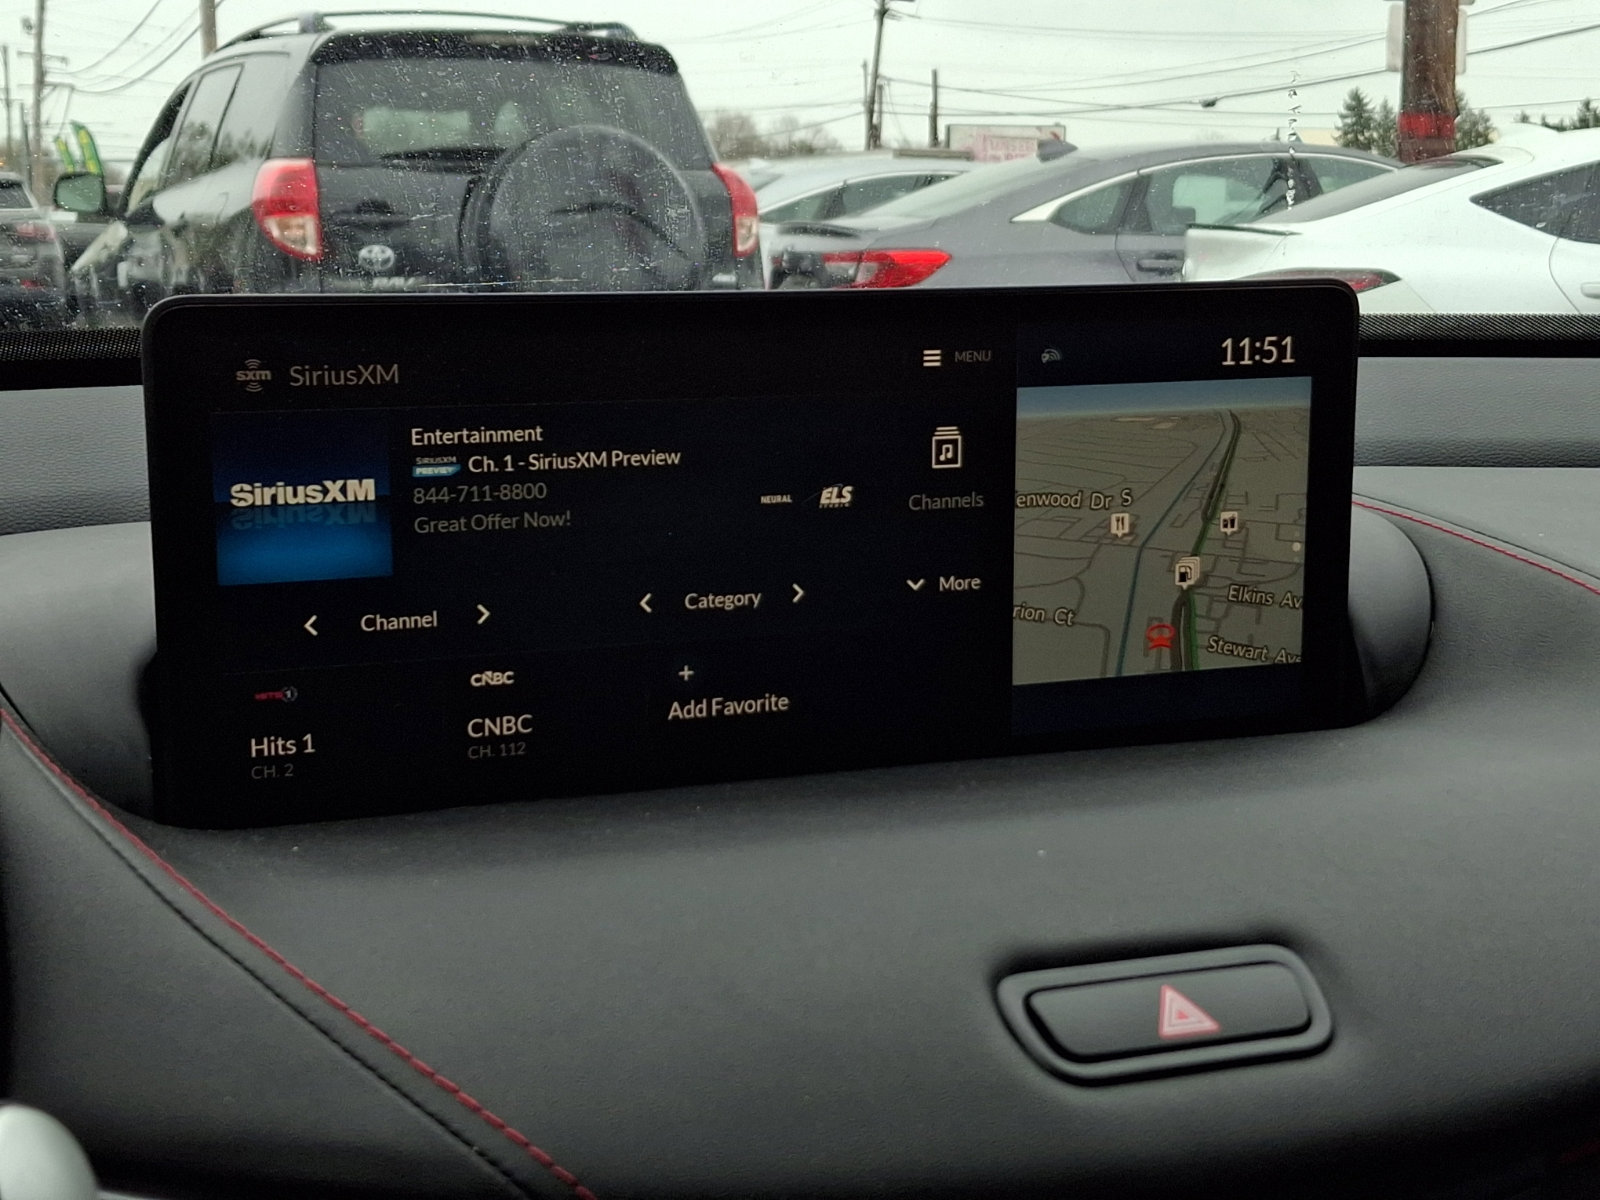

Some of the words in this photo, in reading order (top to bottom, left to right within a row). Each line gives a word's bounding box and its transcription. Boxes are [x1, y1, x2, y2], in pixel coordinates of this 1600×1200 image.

[954, 350, 992, 363] MENU
[1221, 335, 1296, 366] 11:51
[235, 367, 272, 382] sxm
[289, 363, 399, 387] SiriusXM
[411, 425, 543, 446] Entertainment
[468, 455, 499, 473] Ch.
[503, 454, 515, 472] 1
[528, 450, 608, 471] SiriusXM
[611, 448, 681, 467] Preview
[230, 478, 376, 507] SiriusXM
[413, 482, 548, 505] 844-711-8800
[820, 485, 853, 504] ELS
[908, 491, 985, 511] Channels
[1091, 493, 1112, 509] Dr
[1121, 489, 1132, 506] S
[414, 516, 468, 534] Great
[470, 513, 520, 531] Offer
[523, 509, 571, 529] Now!
[939, 575, 982, 592] More
[684, 592, 762, 611] Category
[1228, 585, 1273, 605] Elkins
[360, 610, 438, 632] Channel
[1055, 609, 1074, 625] Ct
[1208, 636, 1268, 661] Stewart
[470, 670, 515, 687] CNBC
[667, 698, 707, 721] Add
[711, 693, 790, 717] Favorite
[467, 713, 533, 738] CNBC
[250, 735, 297, 758] Hits
[302, 733, 316, 753] 1
[467, 744, 494, 760] CH.
[499, 741, 526, 757] 112
[251, 764, 280, 780] CH.
[283, 762, 294, 777] 2
